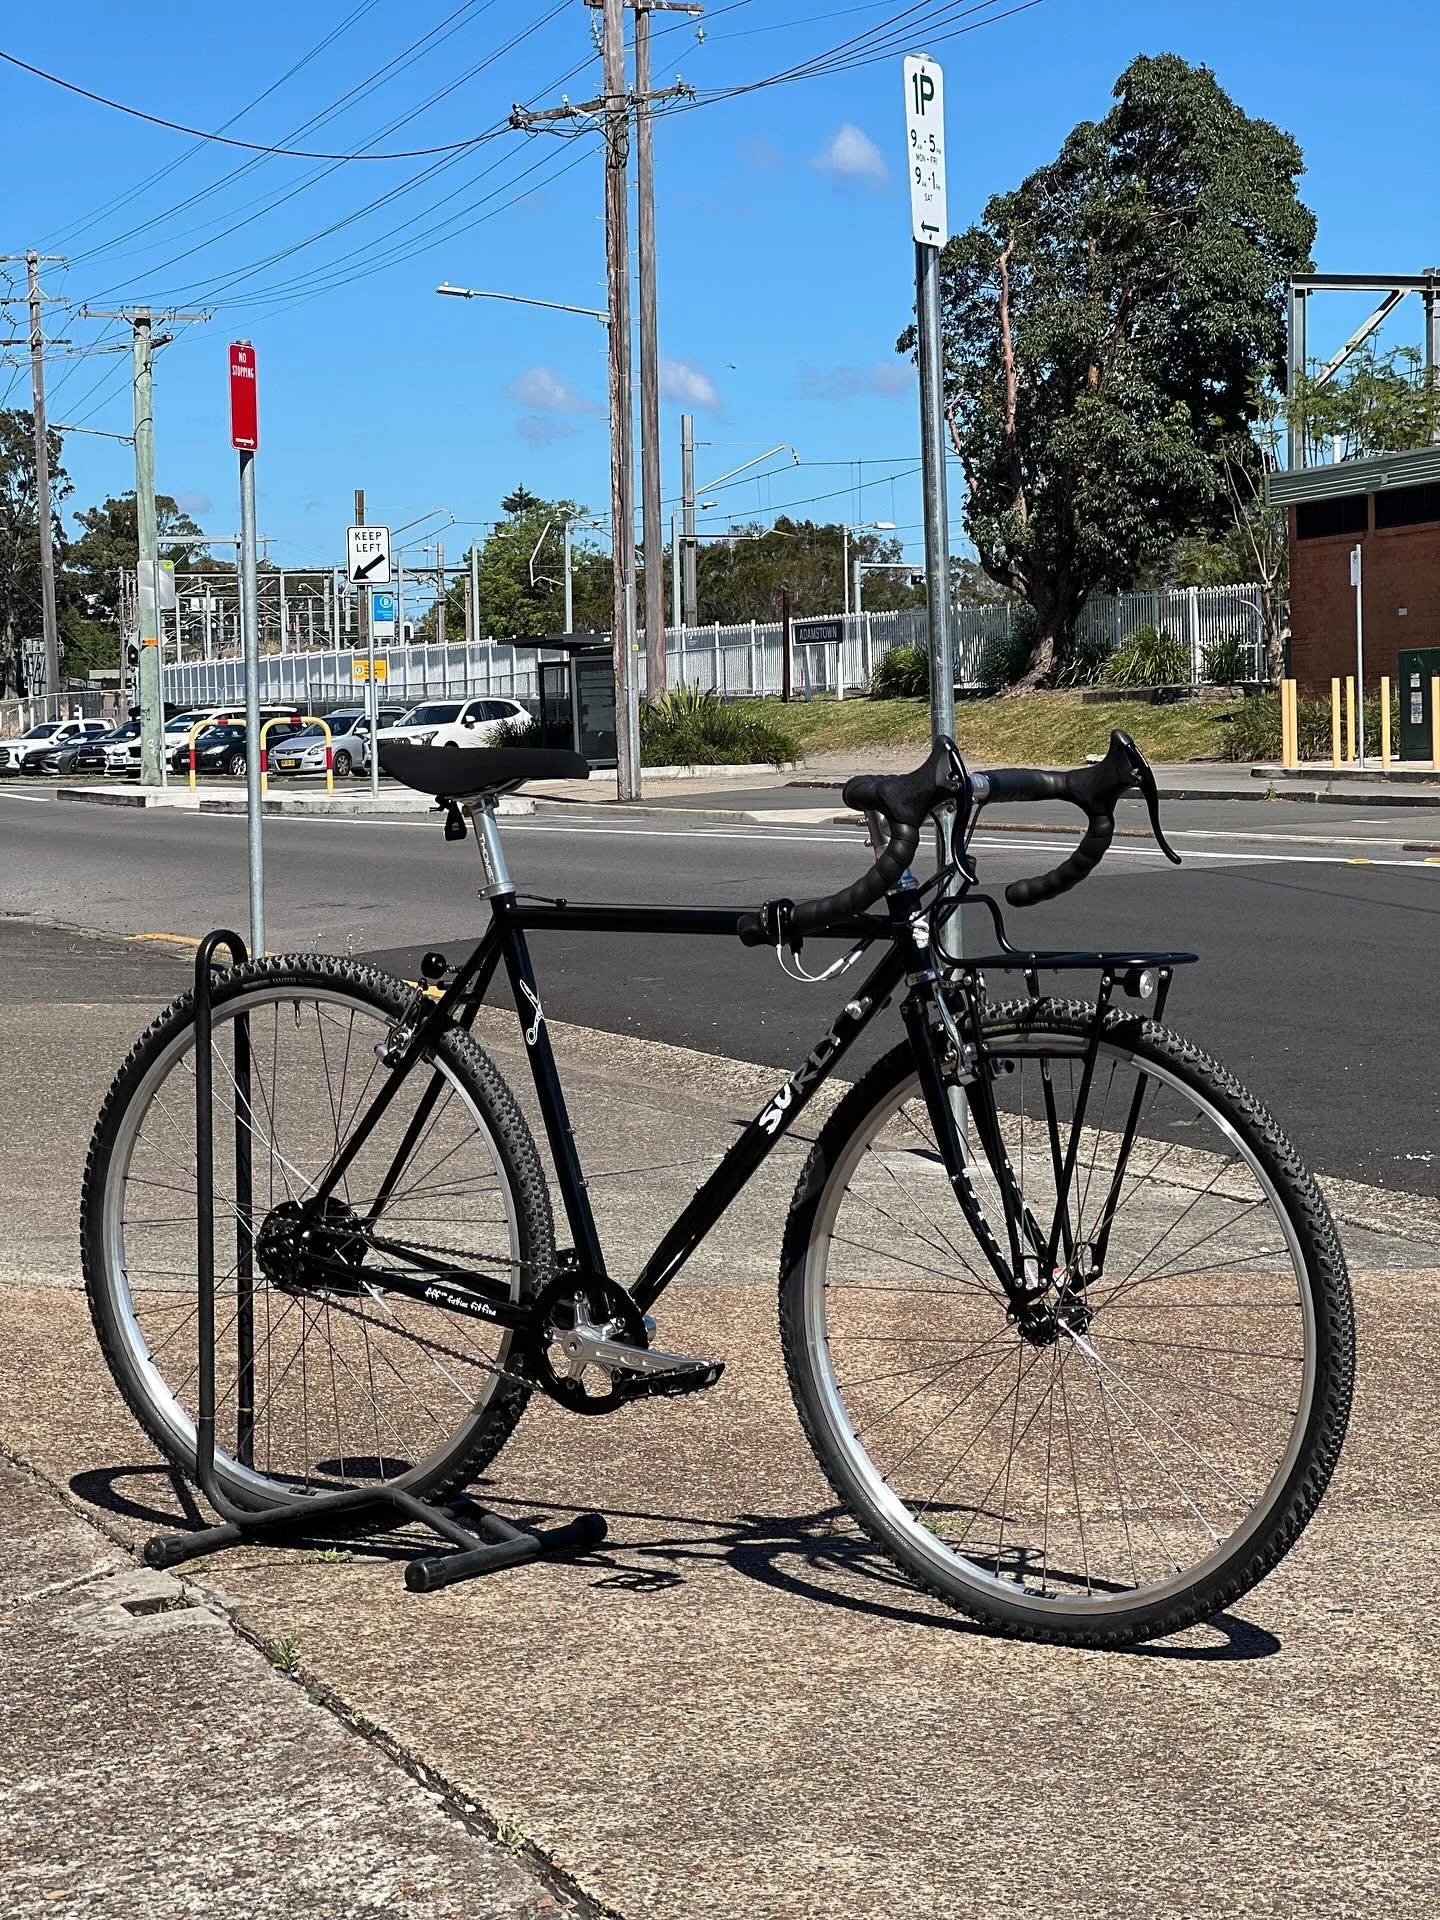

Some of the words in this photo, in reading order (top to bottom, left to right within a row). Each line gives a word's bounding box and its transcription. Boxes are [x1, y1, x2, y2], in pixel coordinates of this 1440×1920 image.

[912, 73, 934, 116] 1P
[238, 351, 247, 363] NO
[232, 365, 254, 378] STOPPING
[354, 531, 382, 541] KEEP
[356, 543, 382, 553] LEFT
[799, 626, 838, 640] ADAMSTOWN
[479, 832, 495, 884] THOMSO
